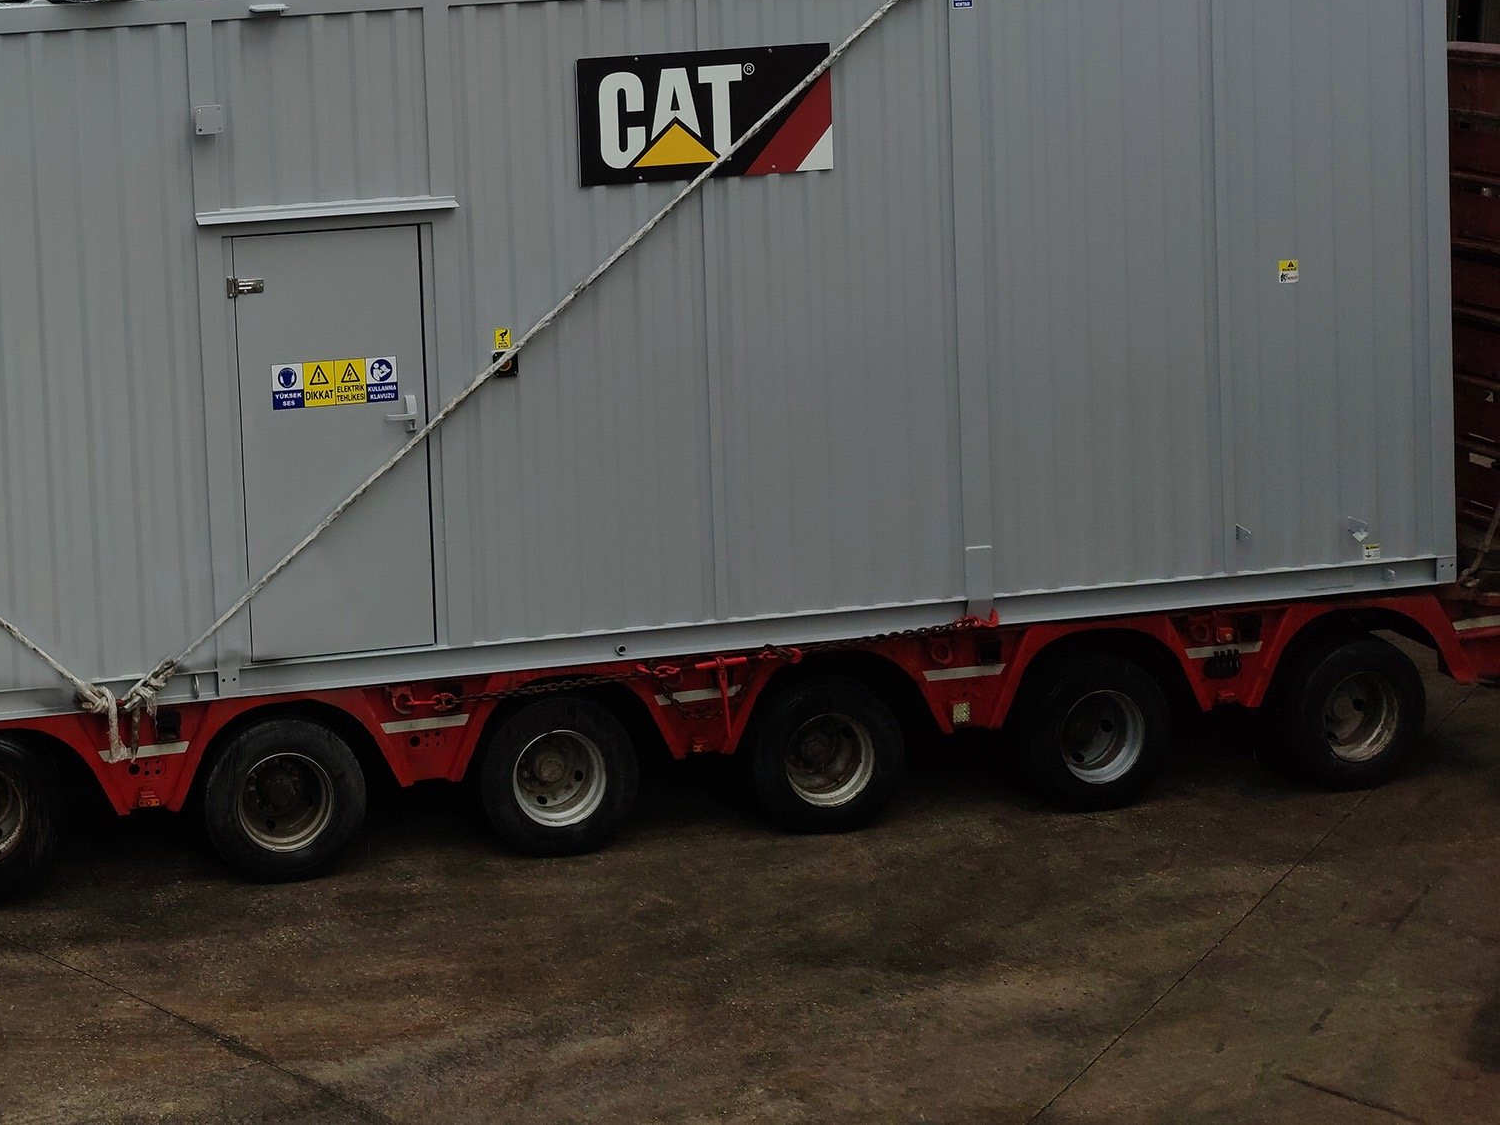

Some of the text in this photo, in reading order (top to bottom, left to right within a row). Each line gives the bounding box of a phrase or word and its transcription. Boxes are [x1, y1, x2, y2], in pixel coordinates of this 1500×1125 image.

[367, 385, 397, 393] KULLANMA
[275, 392, 302, 400] YÜKSEK
[306, 389, 334, 401] DİKKAT
[370, 392, 395, 400] KLAVUZU
